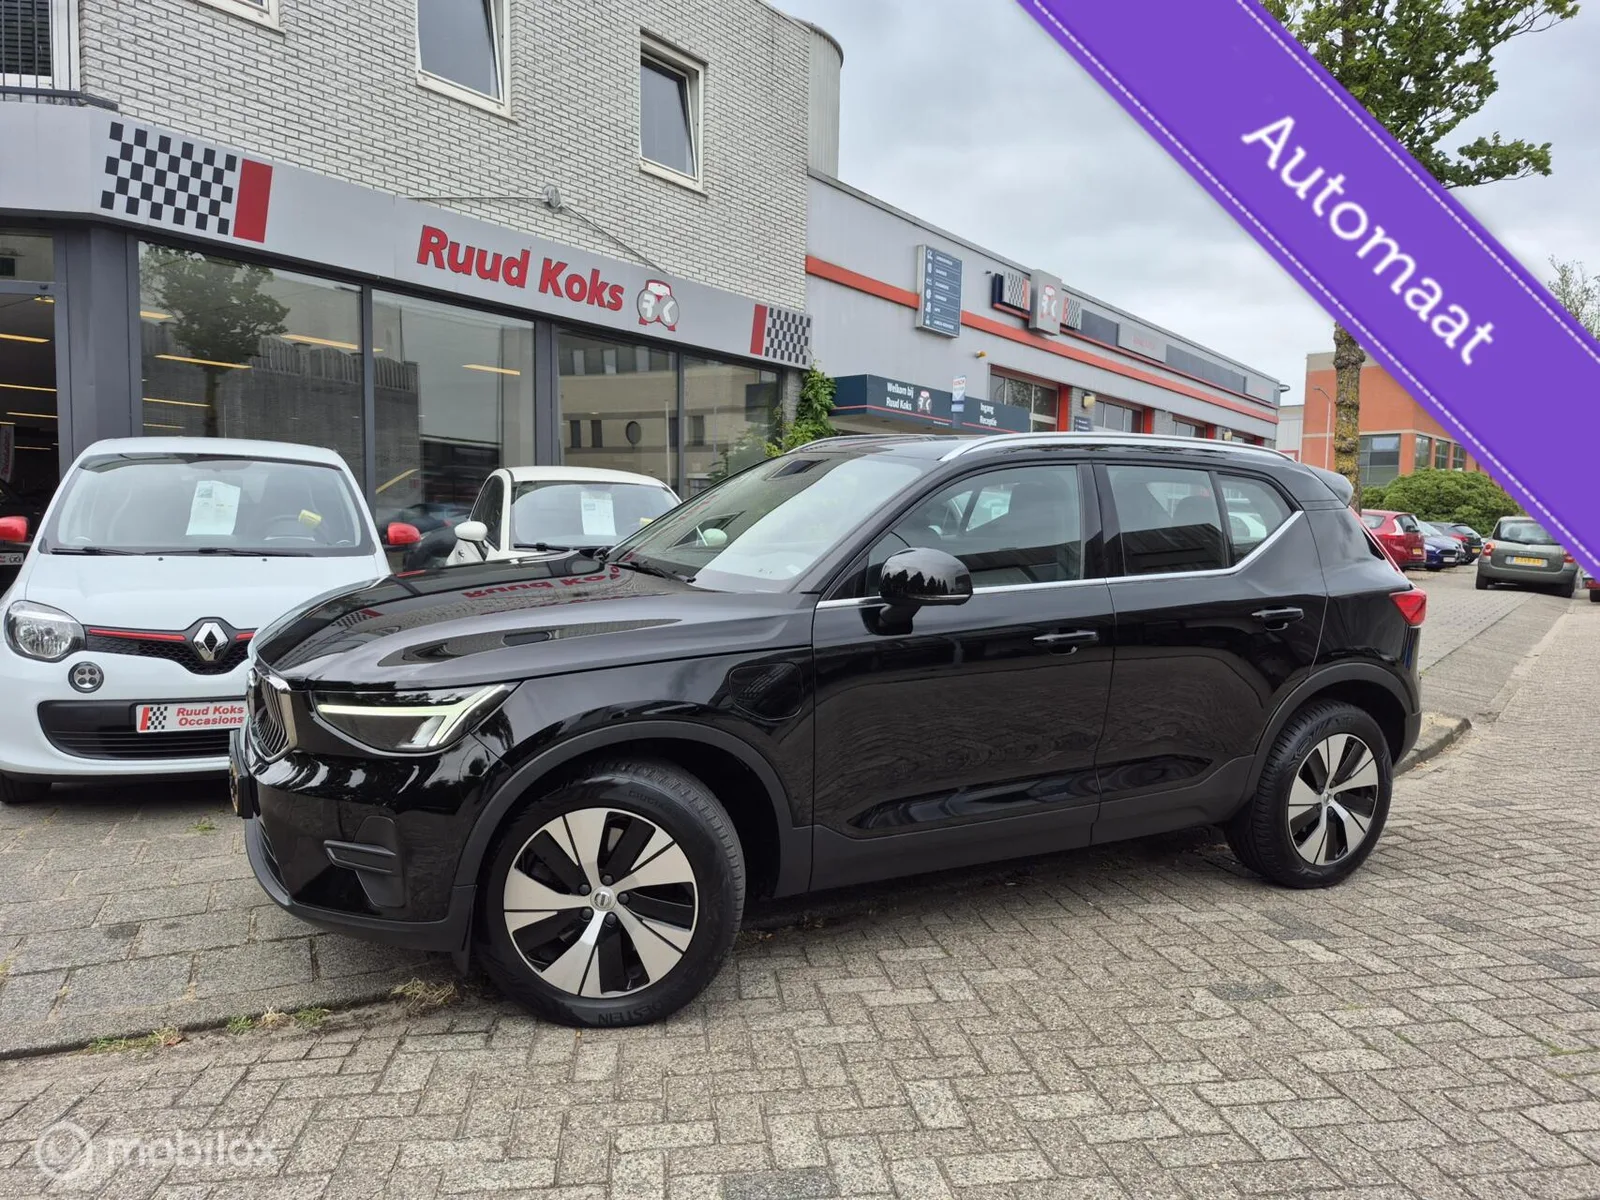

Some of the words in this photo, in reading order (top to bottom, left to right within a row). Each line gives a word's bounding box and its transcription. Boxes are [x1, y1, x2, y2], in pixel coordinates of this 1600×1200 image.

[416, 224, 531, 289] Ruud
[538, 257, 625, 312] Koks
[886, 382, 907, 396] Welkom
[886, 396, 900, 409] Ruud
[900, 399, 912, 411] Koks
[176, 706, 210, 717] Ruud
[213, 705, 244, 715] Koks
[178, 716, 244, 727] Occasions
